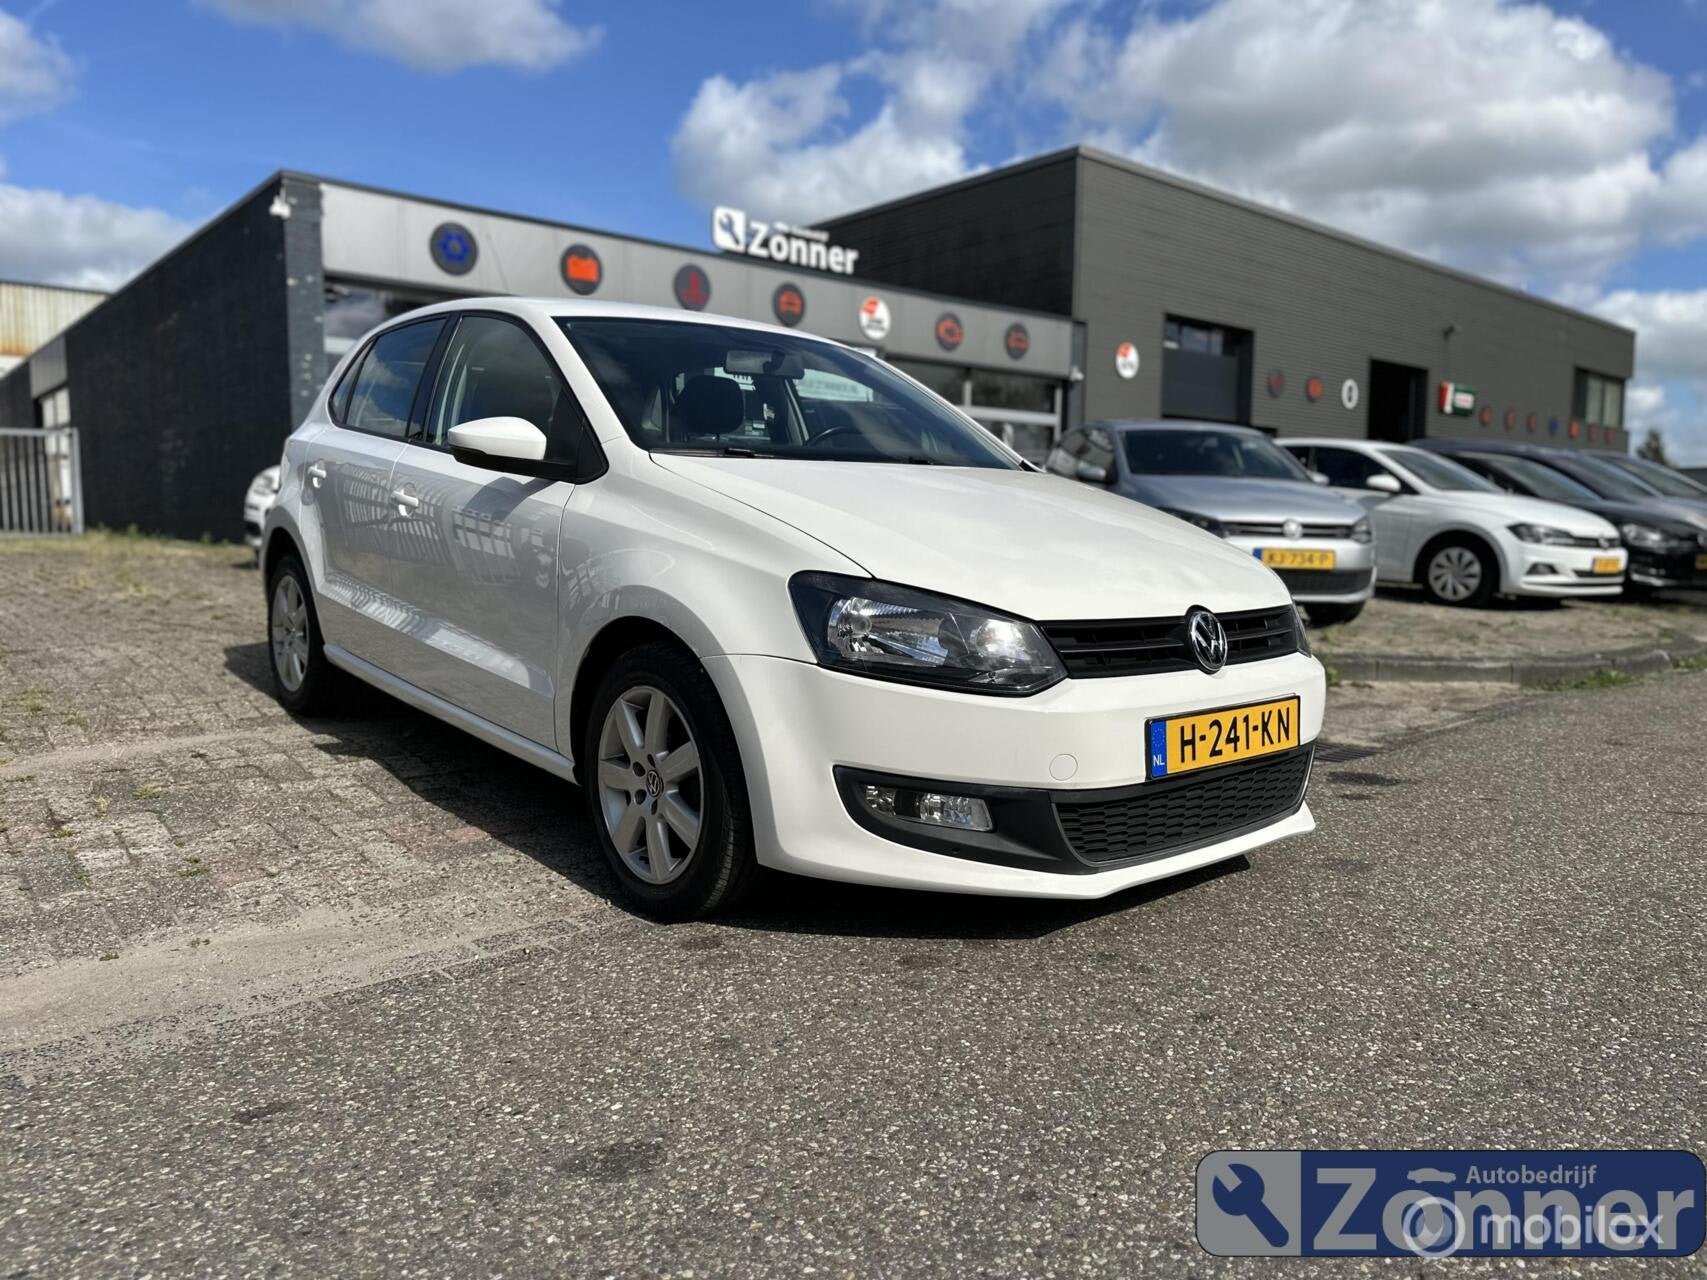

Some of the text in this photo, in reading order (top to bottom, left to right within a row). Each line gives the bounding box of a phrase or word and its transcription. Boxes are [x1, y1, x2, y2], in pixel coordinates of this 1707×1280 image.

[748, 220, 859, 275] Zonner
[1153, 754, 1165, 767] NL
[1180, 706, 1290, 763] H-241-KN
